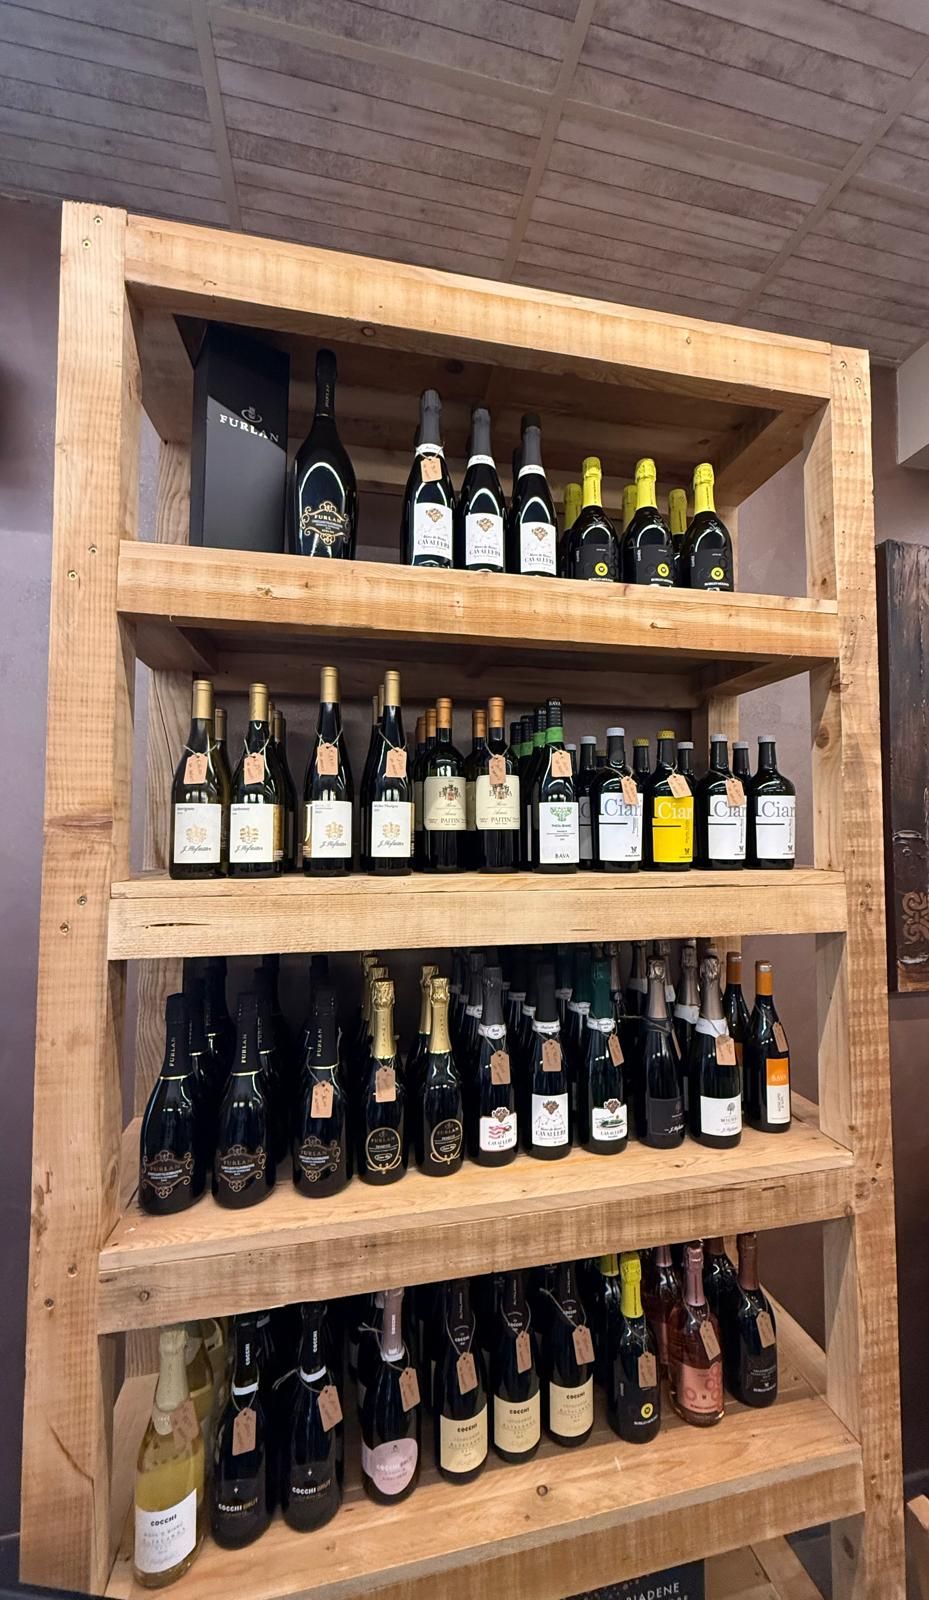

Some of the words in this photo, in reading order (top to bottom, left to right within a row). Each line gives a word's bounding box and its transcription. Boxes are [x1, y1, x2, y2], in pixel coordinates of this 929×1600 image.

[219, 414, 280, 442] FURLAN
[314, 514, 342, 524] FURLAN
[566, 1392, 586, 1400] COCCHI
[457, 1423, 478, 1433] COCCHI
[292, 1487, 316, 1495] COCCHI
[218, 1504, 242, 1512] COCCHI
[150, 1514, 177, 1527] COCCHI
